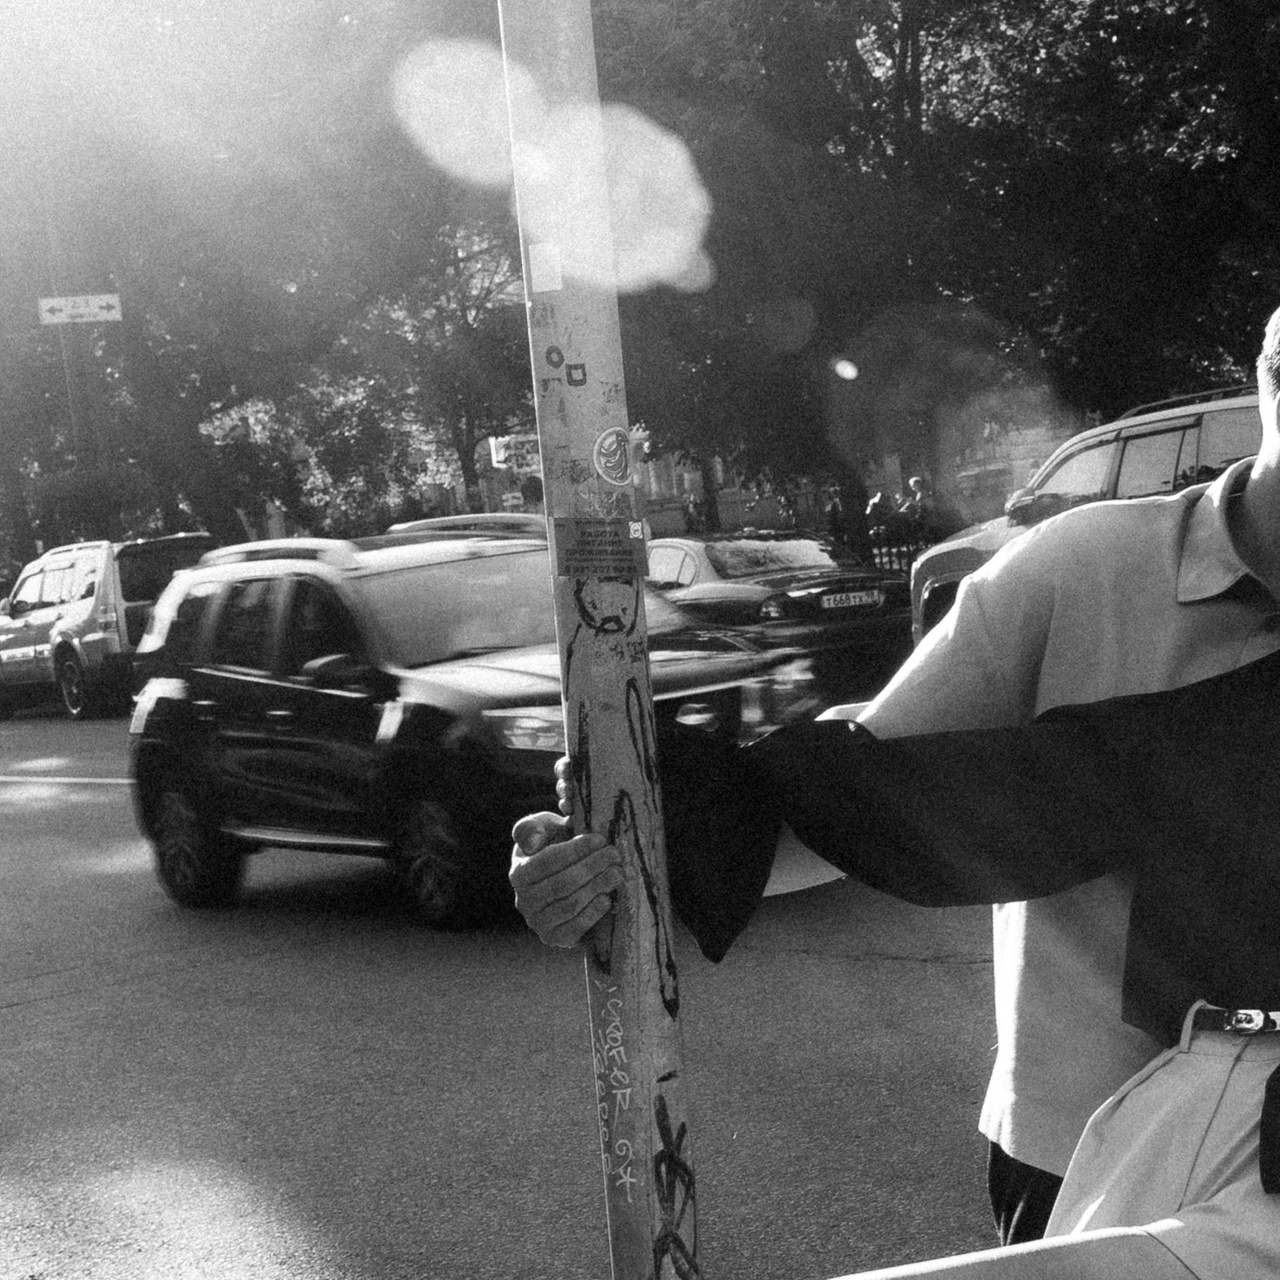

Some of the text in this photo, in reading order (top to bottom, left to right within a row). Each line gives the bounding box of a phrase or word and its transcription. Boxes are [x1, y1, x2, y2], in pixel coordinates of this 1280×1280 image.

[580, 530, 619, 538] РАБОТА
[576, 539, 623, 547] ПИТАНИЕ
[565, 548, 633, 556] ПРОЖИВАНИЕ
